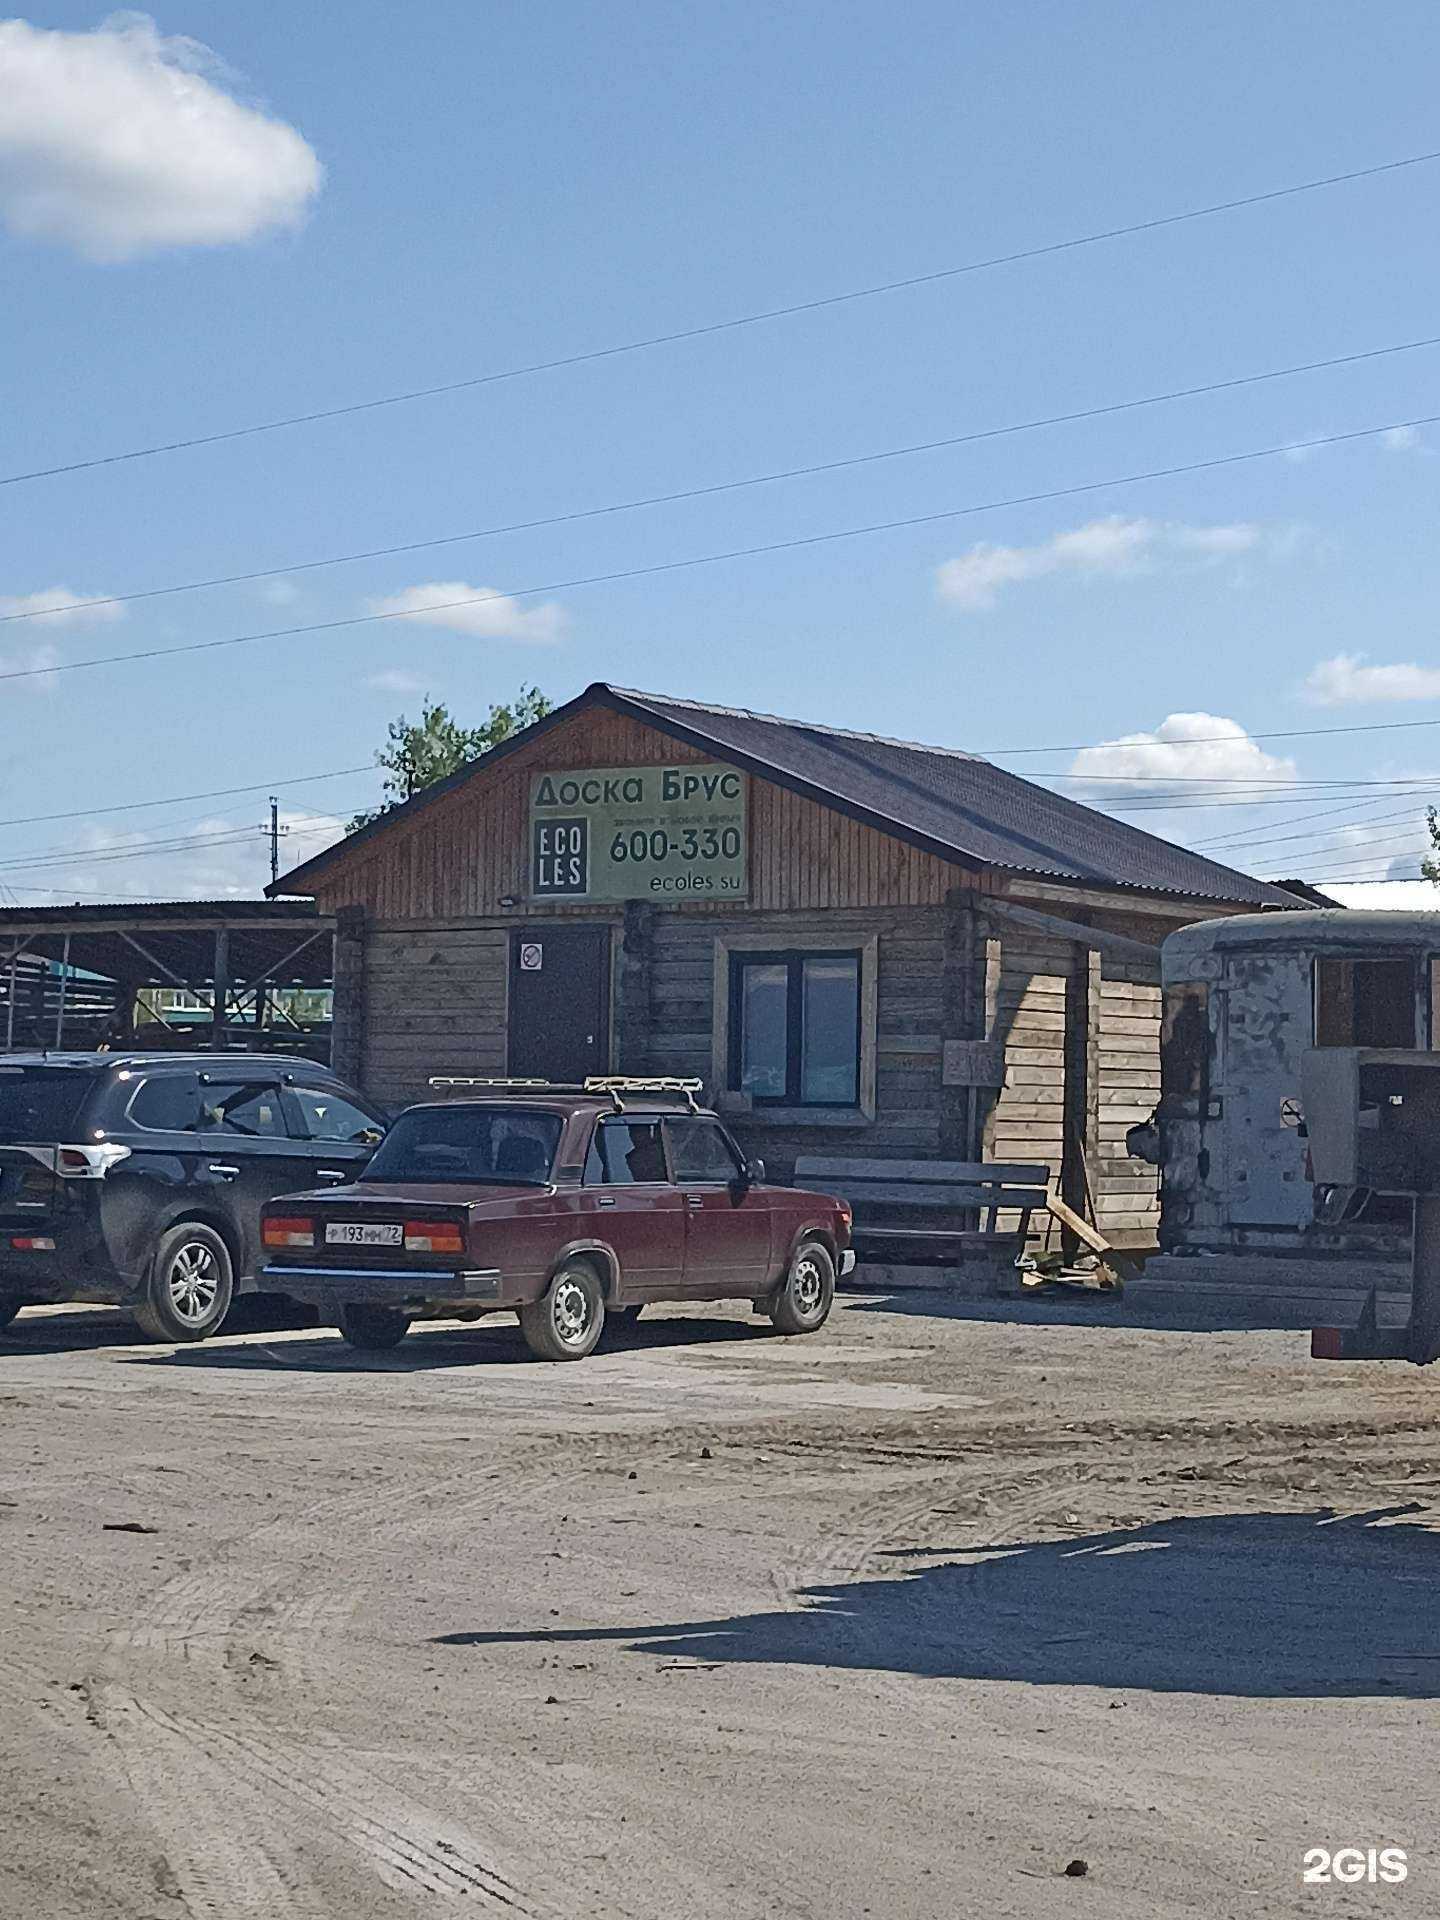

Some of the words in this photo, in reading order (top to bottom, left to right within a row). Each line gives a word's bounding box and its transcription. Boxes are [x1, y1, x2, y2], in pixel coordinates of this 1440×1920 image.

[540, 826, 581, 855] ECO
[610, 827, 741, 862] 600-330
[539, 857, 581, 886] LES
